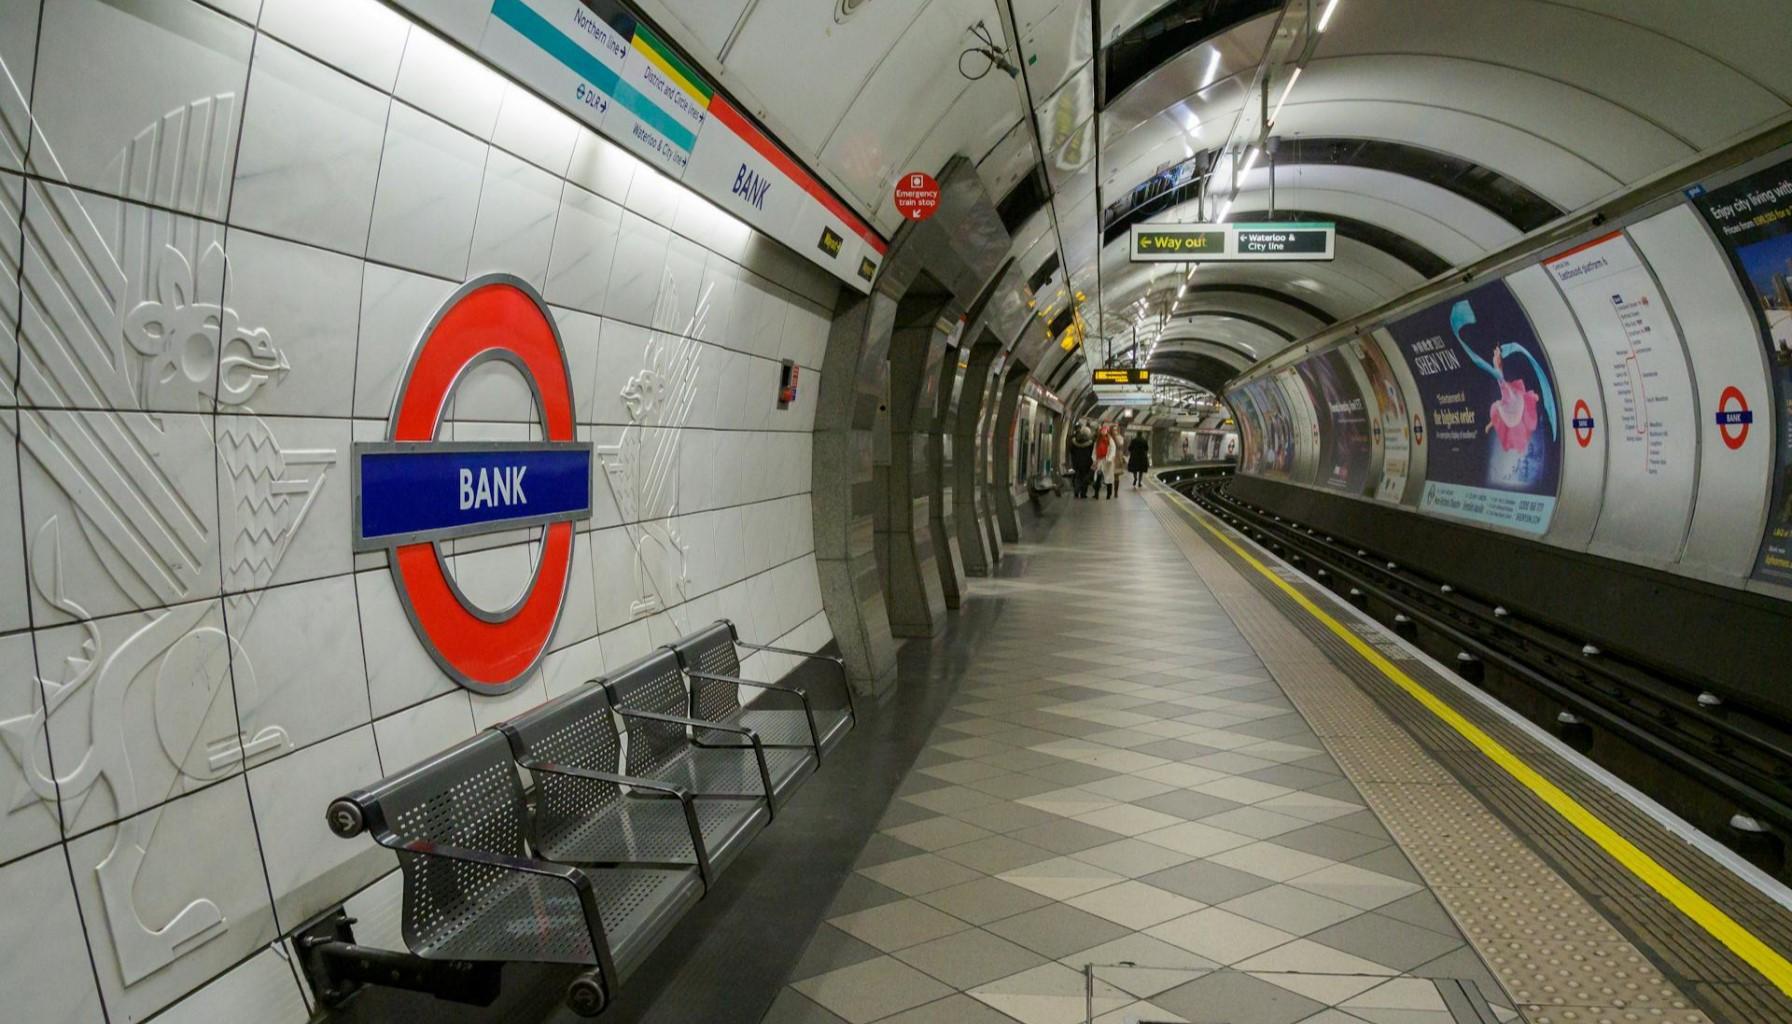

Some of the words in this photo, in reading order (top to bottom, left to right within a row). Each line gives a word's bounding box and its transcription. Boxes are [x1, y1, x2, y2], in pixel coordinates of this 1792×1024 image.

[574, 7, 607, 45] Northern
[606, 35, 619, 55] line
[585, 89, 601, 110] DLR
[644, 65, 665, 92] District
[674, 90, 689, 112] Circle
[632, 122, 658, 149] Waterloo
[662, 143, 674, 161] City
[732, 162, 771, 211] BANK
[896, 189, 938, 199] Emergency
[899, 199, 917, 207] train
[917, 199, 936, 208] stop
[1710, 205, 1736, 220] Enjoy
[1734, 198, 1752, 212] city
[1747, 190, 1777, 206] living
[1154, 236, 1182, 251] Way
[1185, 236, 1208, 248] out
[1248, 234, 1287, 242] Waterloo
[1288, 233, 1296, 241] &
[1248, 242, 1266, 252] City
[1268, 242, 1285, 251] line
[1415, 353, 1441, 376] SHEN
[1436, 348, 1461, 372] YUN
[1727, 413, 1742, 423] BANK
[460, 465, 527, 511] BANK
